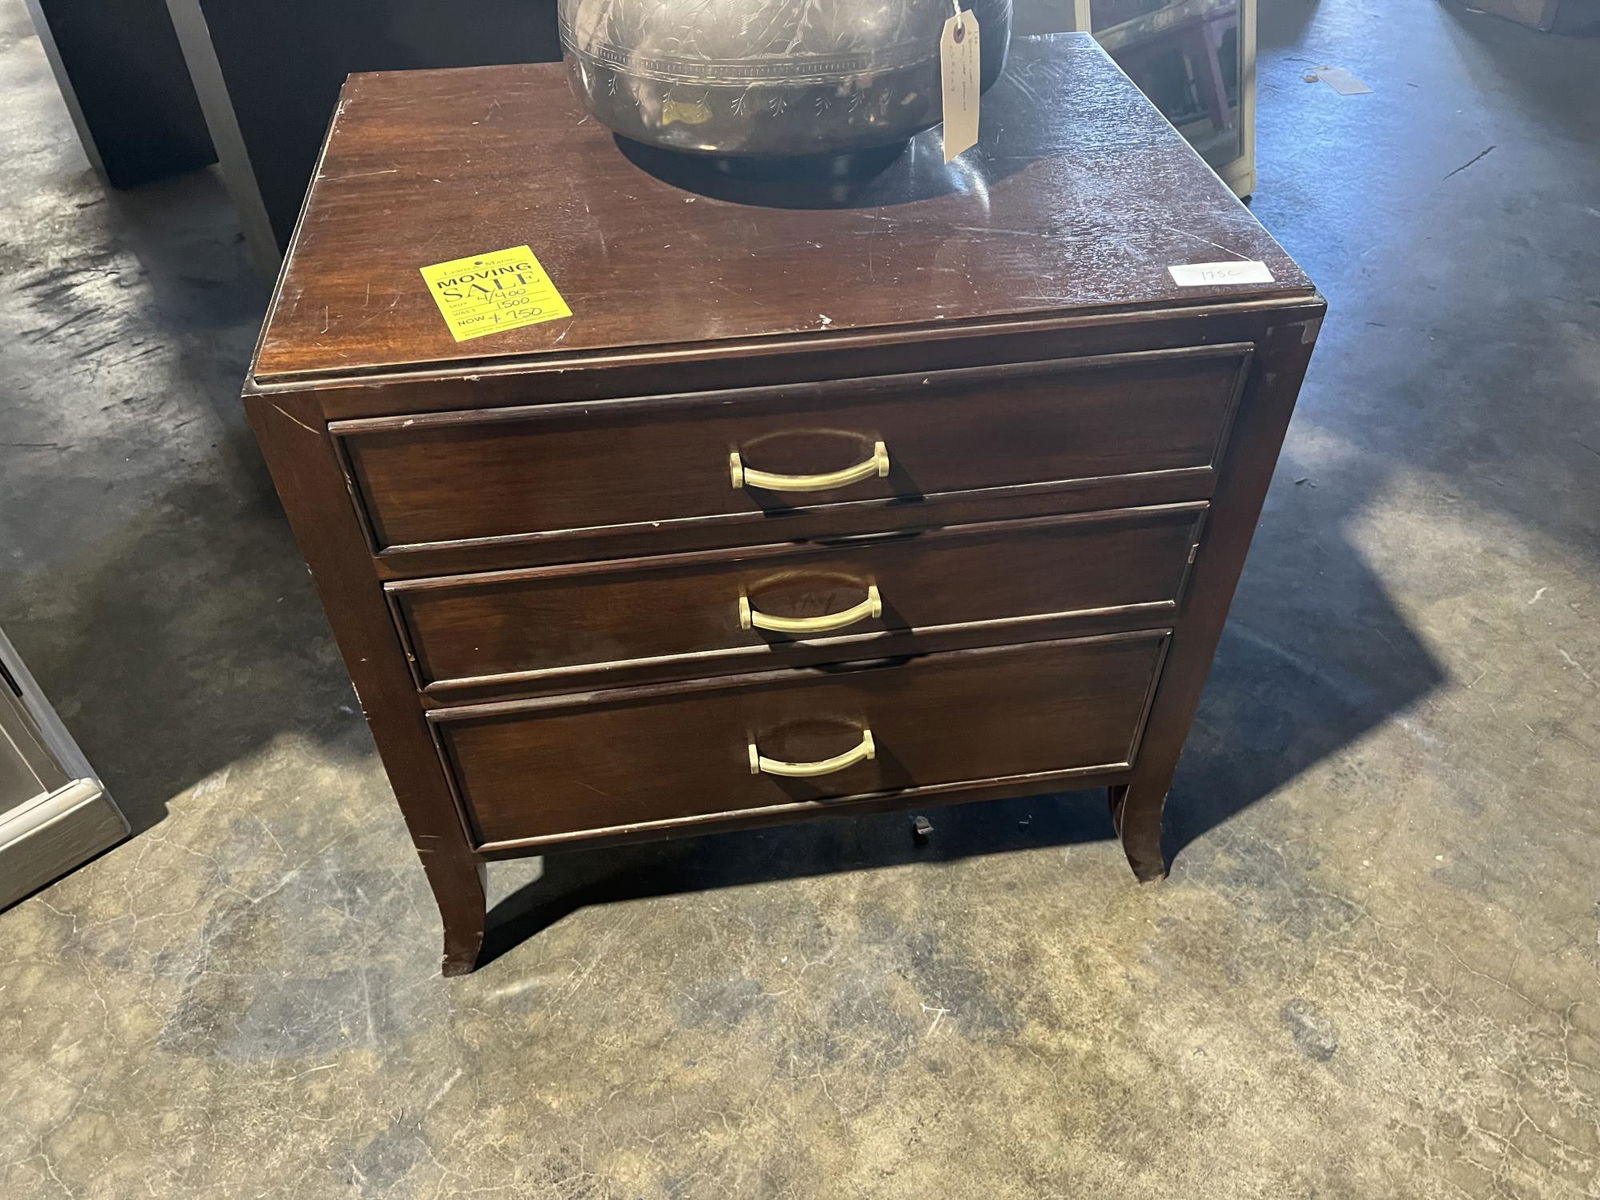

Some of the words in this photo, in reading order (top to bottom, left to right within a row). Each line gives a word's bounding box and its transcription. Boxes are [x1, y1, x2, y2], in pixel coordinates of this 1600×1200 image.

[437, 263, 532, 288] MOVING
[443, 271, 540, 303] SALE
[496, 297, 530, 309] 1500
[457, 315, 485, 326] NOW
[506, 307, 543, 319] 750
